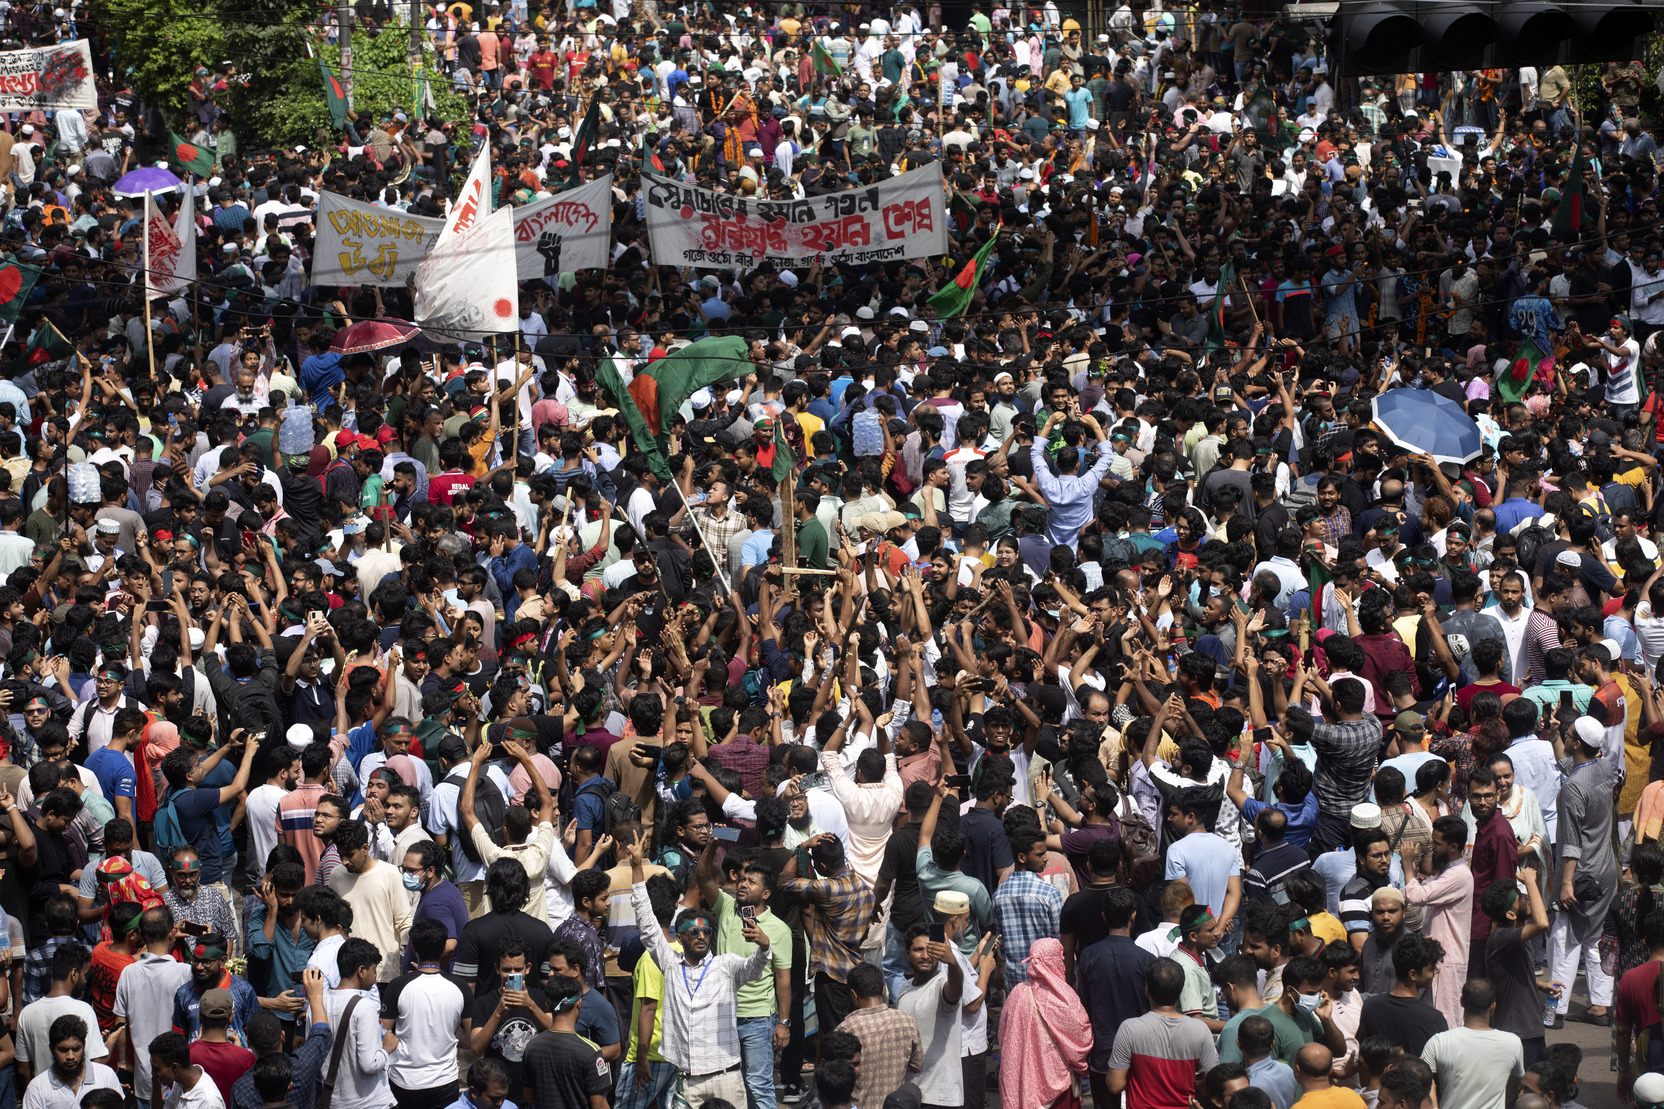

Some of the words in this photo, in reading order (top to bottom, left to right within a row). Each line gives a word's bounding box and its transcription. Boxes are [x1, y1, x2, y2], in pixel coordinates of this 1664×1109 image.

[514, 201, 600, 241] বাংলাদেশ
[756, 200, 816, 226] হয়নি
[824, 187, 879, 218] পতন
[801, 215, 870, 252] হয়নি
[882, 196, 934, 240] শেষ
[328, 210, 425, 244] আওয়াজ
[735, 251, 754, 267] বীর
[855, 244, 905, 262] বাংলাদেশ
